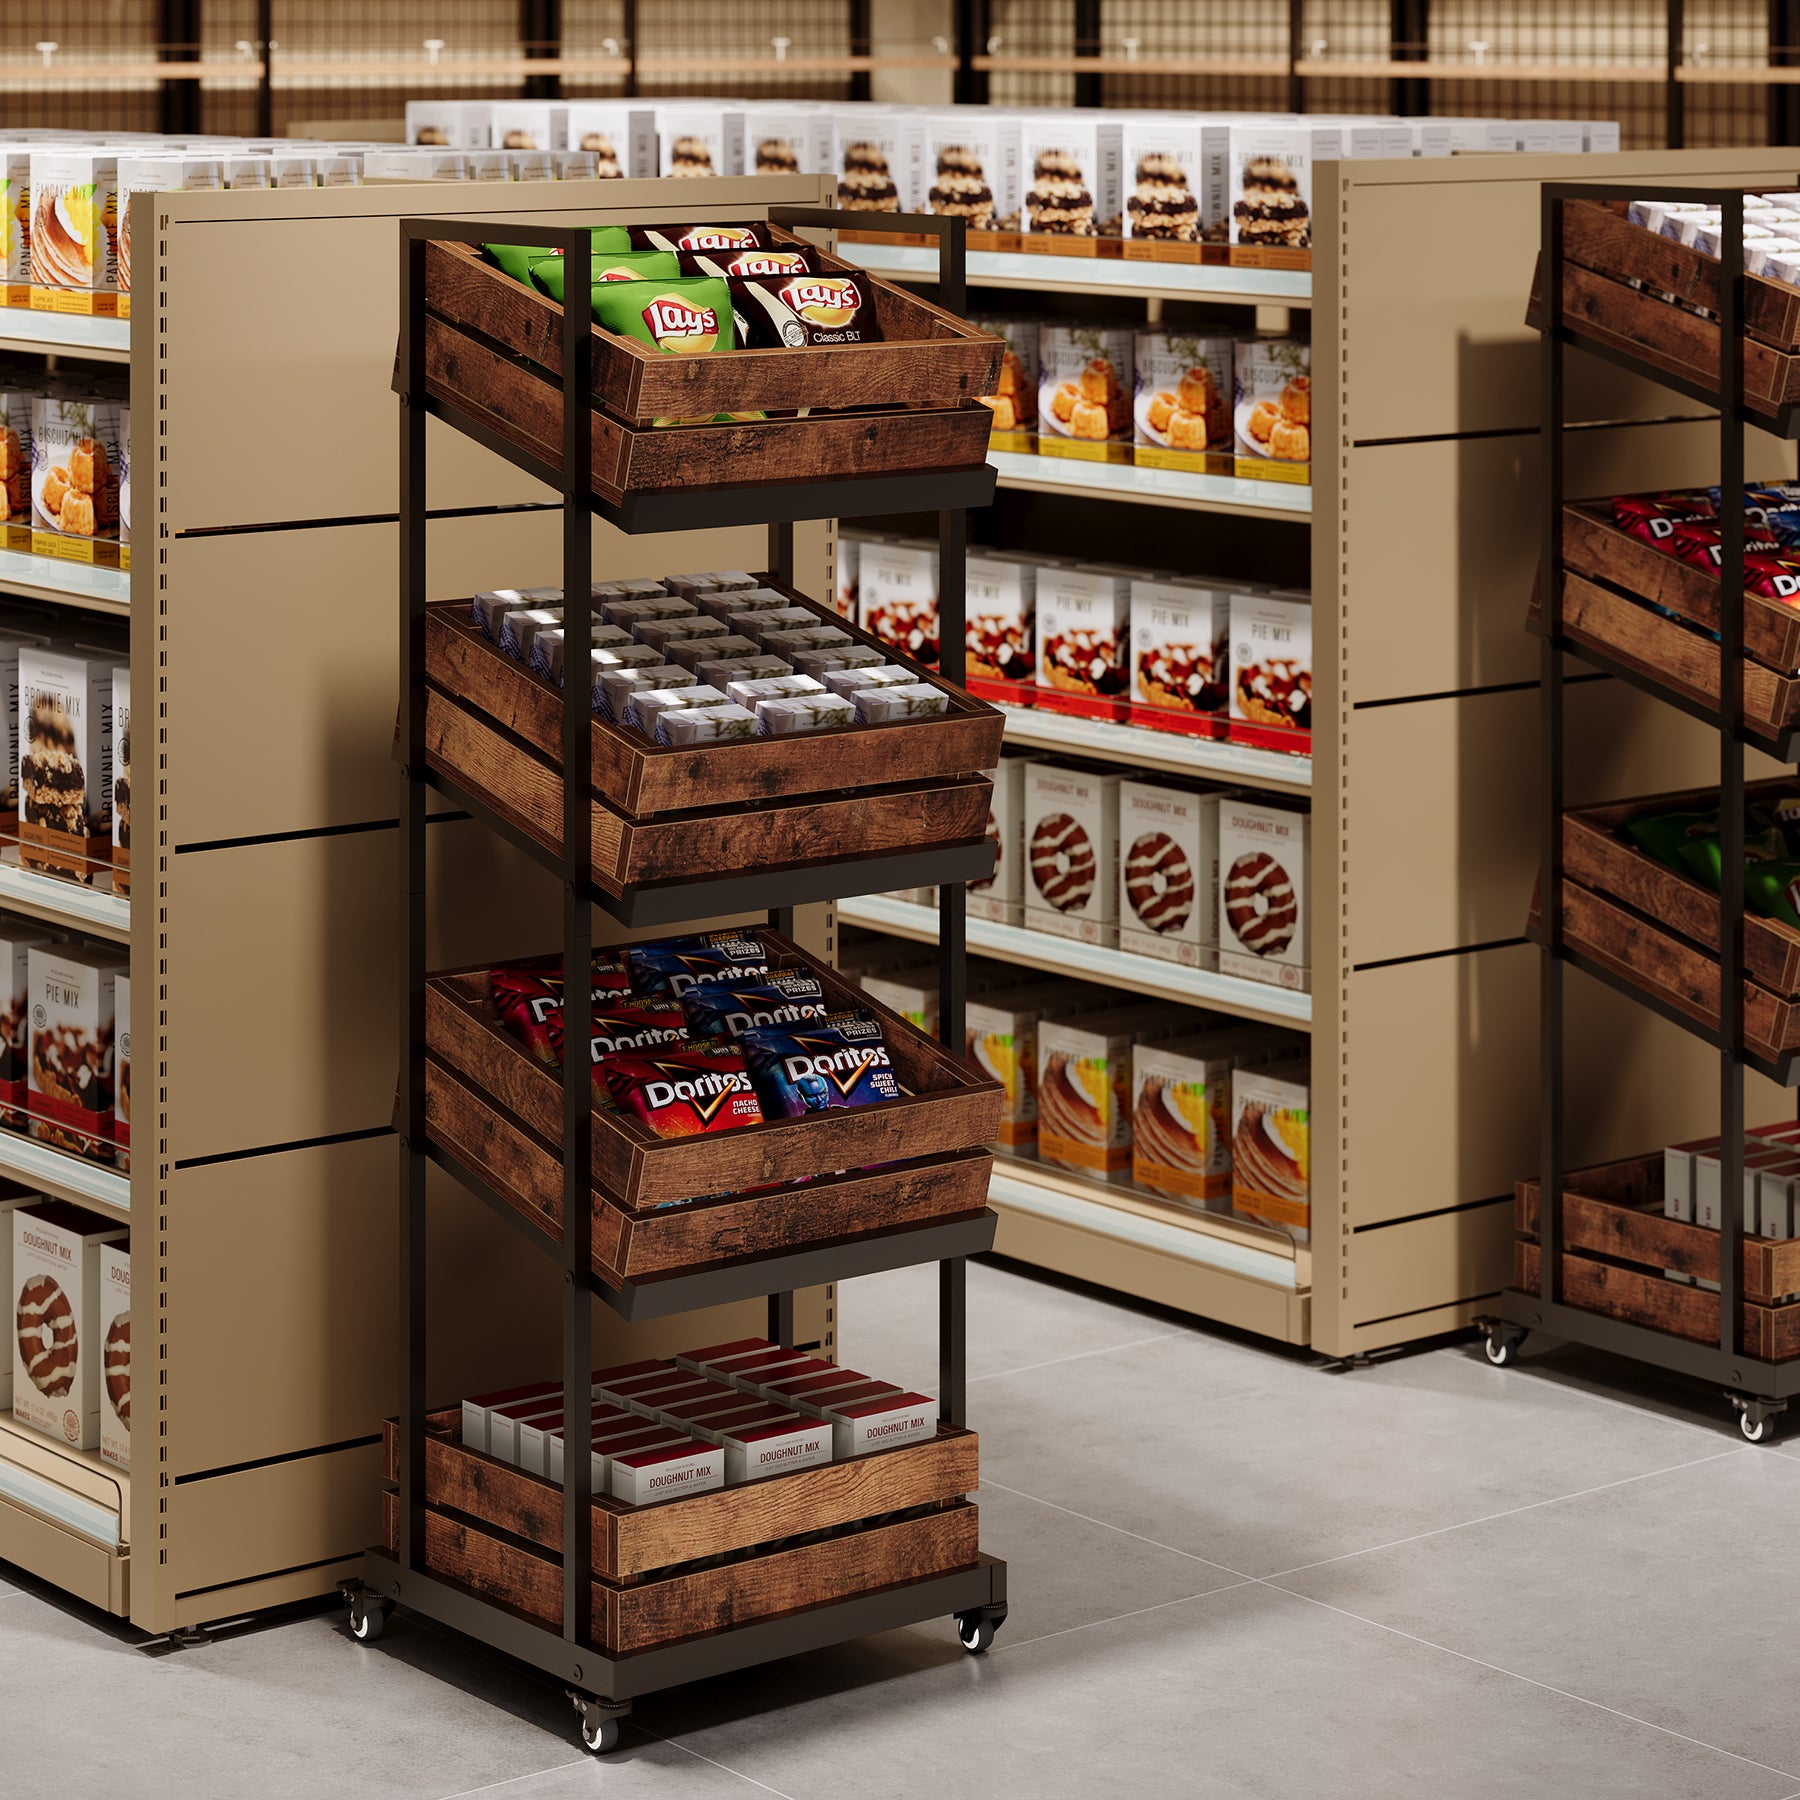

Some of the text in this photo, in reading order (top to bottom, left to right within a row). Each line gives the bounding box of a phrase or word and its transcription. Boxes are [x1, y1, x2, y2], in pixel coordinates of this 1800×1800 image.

[36, 182, 69, 200] PANCAKE
[106, 190, 117, 283] PANCAKE MIX
[790, 284, 856, 311] Lay's
[648, 302, 714, 339] Lay's
[813, 331, 846, 343] Classic
[846, 330, 861, 341] BLT
[38, 427, 69, 446] BISCUIT
[106, 440, 119, 464] MIX
[1252, 624, 1267, 640] PIE
[24, 686, 81, 718] BROWNIE MIX
[102, 703, 113, 824] BROWNIE MIX
[729, 948, 761, 957] PRIZES
[46, 984, 80, 1009] PIE MIX
[785, 985, 817, 994] PRIZES
[845, 1028, 878, 1037] PRIZES
[712, 1046, 729, 1055] WIN
[784, 1046, 891, 1082] Doritos
[645, 1071, 753, 1108] Doritos
[870, 1079, 895, 1088] SWEET
[880, 1086, 898, 1094] CHILI
[732, 1105, 760, 1115] CHEESE
[733, 1099, 758, 1107] NACHO
[23, 1231, 58, 1255] DOUGHNUT
[59, 1245, 72, 1261] MIX
[111, 1266, 130, 1284] DOUG
[15, 1408, 30, 1421] MAKES
[867, 1420, 909, 1438] DOUGHNUT
[910, 1417, 925, 1429] MIX
[102, 1447, 119, 1461] MAKES
[760, 1444, 803, 1463] DOUGHNUT
[805, 1441, 820, 1453] MIX
[649, 1469, 694, 1488] DOUGHNUT
[696, 1465, 712, 1478] MIX
